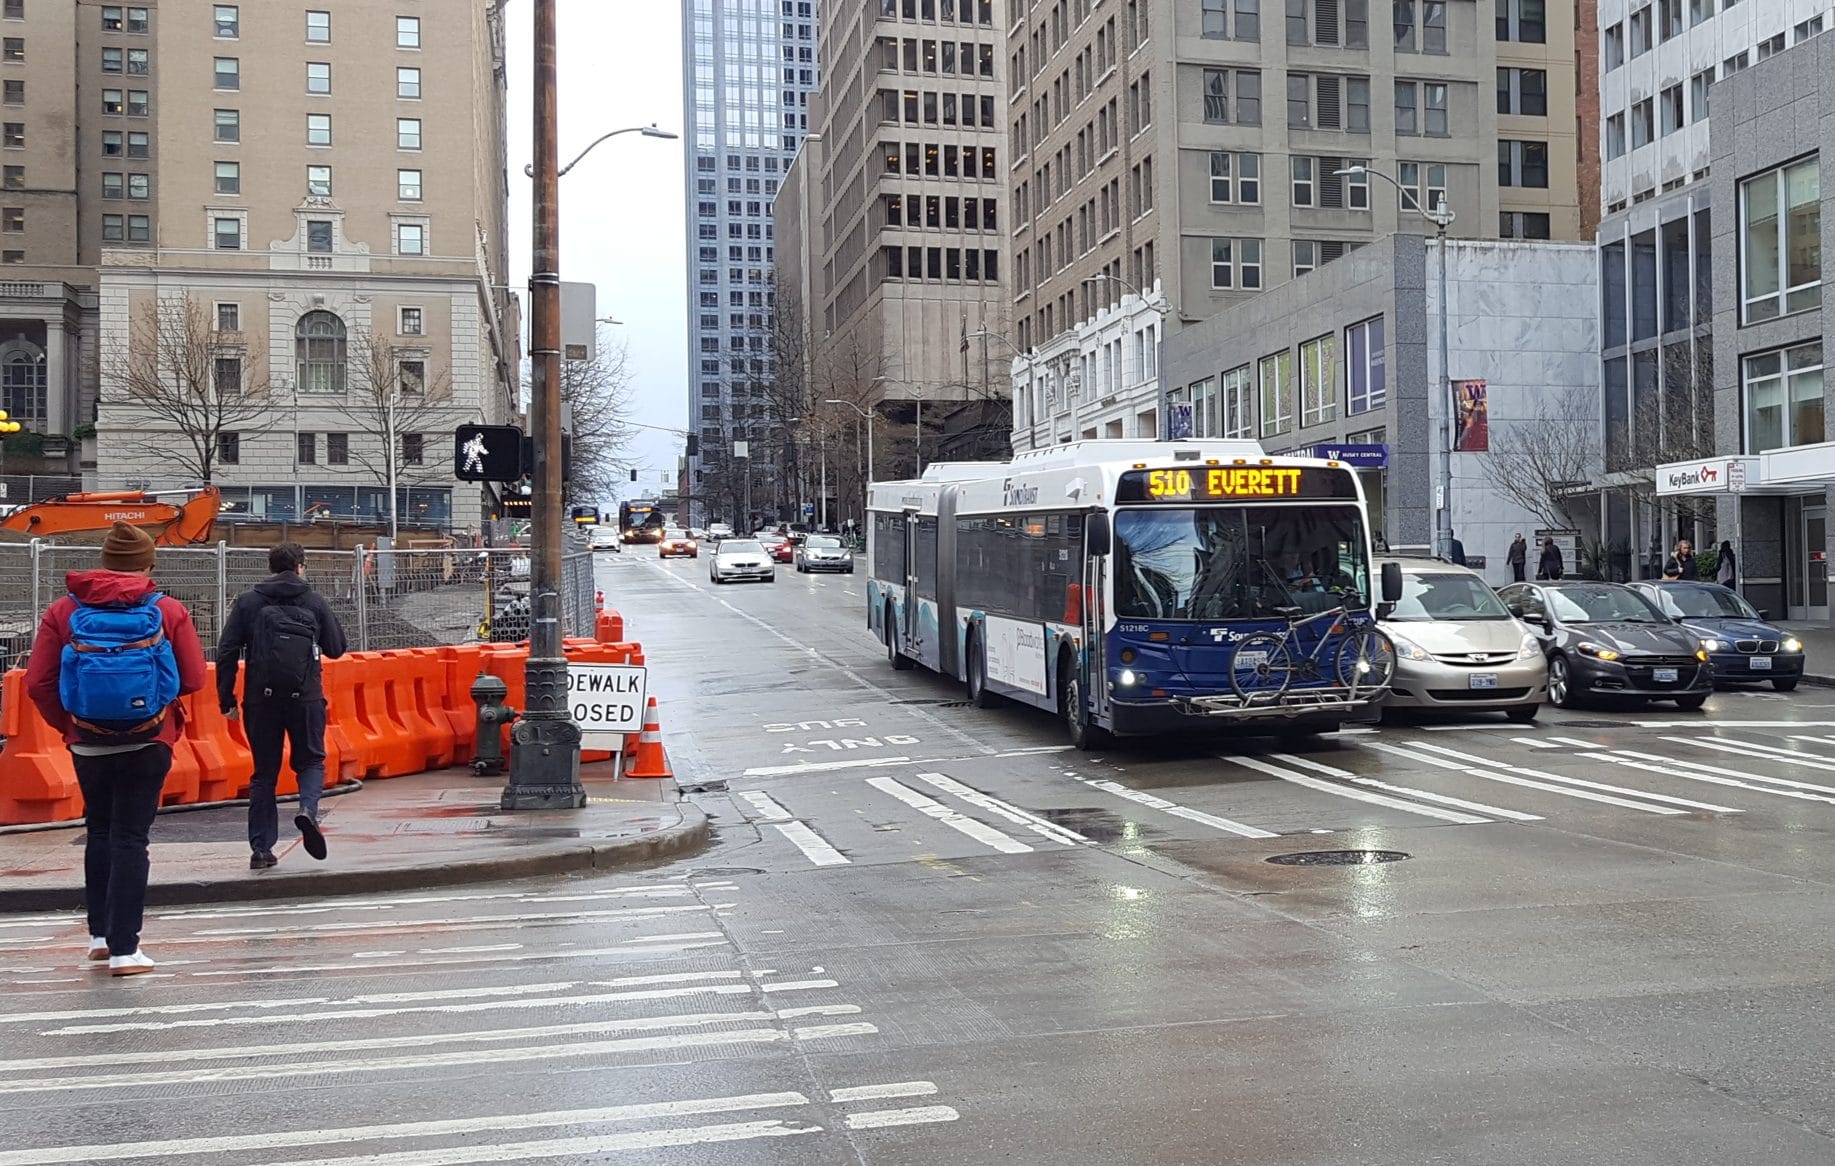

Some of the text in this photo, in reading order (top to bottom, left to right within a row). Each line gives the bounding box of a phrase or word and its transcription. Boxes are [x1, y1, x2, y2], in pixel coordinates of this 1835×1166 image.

[1327, 450, 1340, 460] W
[1149, 469, 1301, 496] 510 EVERETT
[1669, 471, 1701, 488] KeyBank
[104, 511, 145, 520] HITACHI
[566, 673, 639, 693] DEWALK
[573, 703, 634, 722] OSED
[781, 735, 921, 754] ONLY
